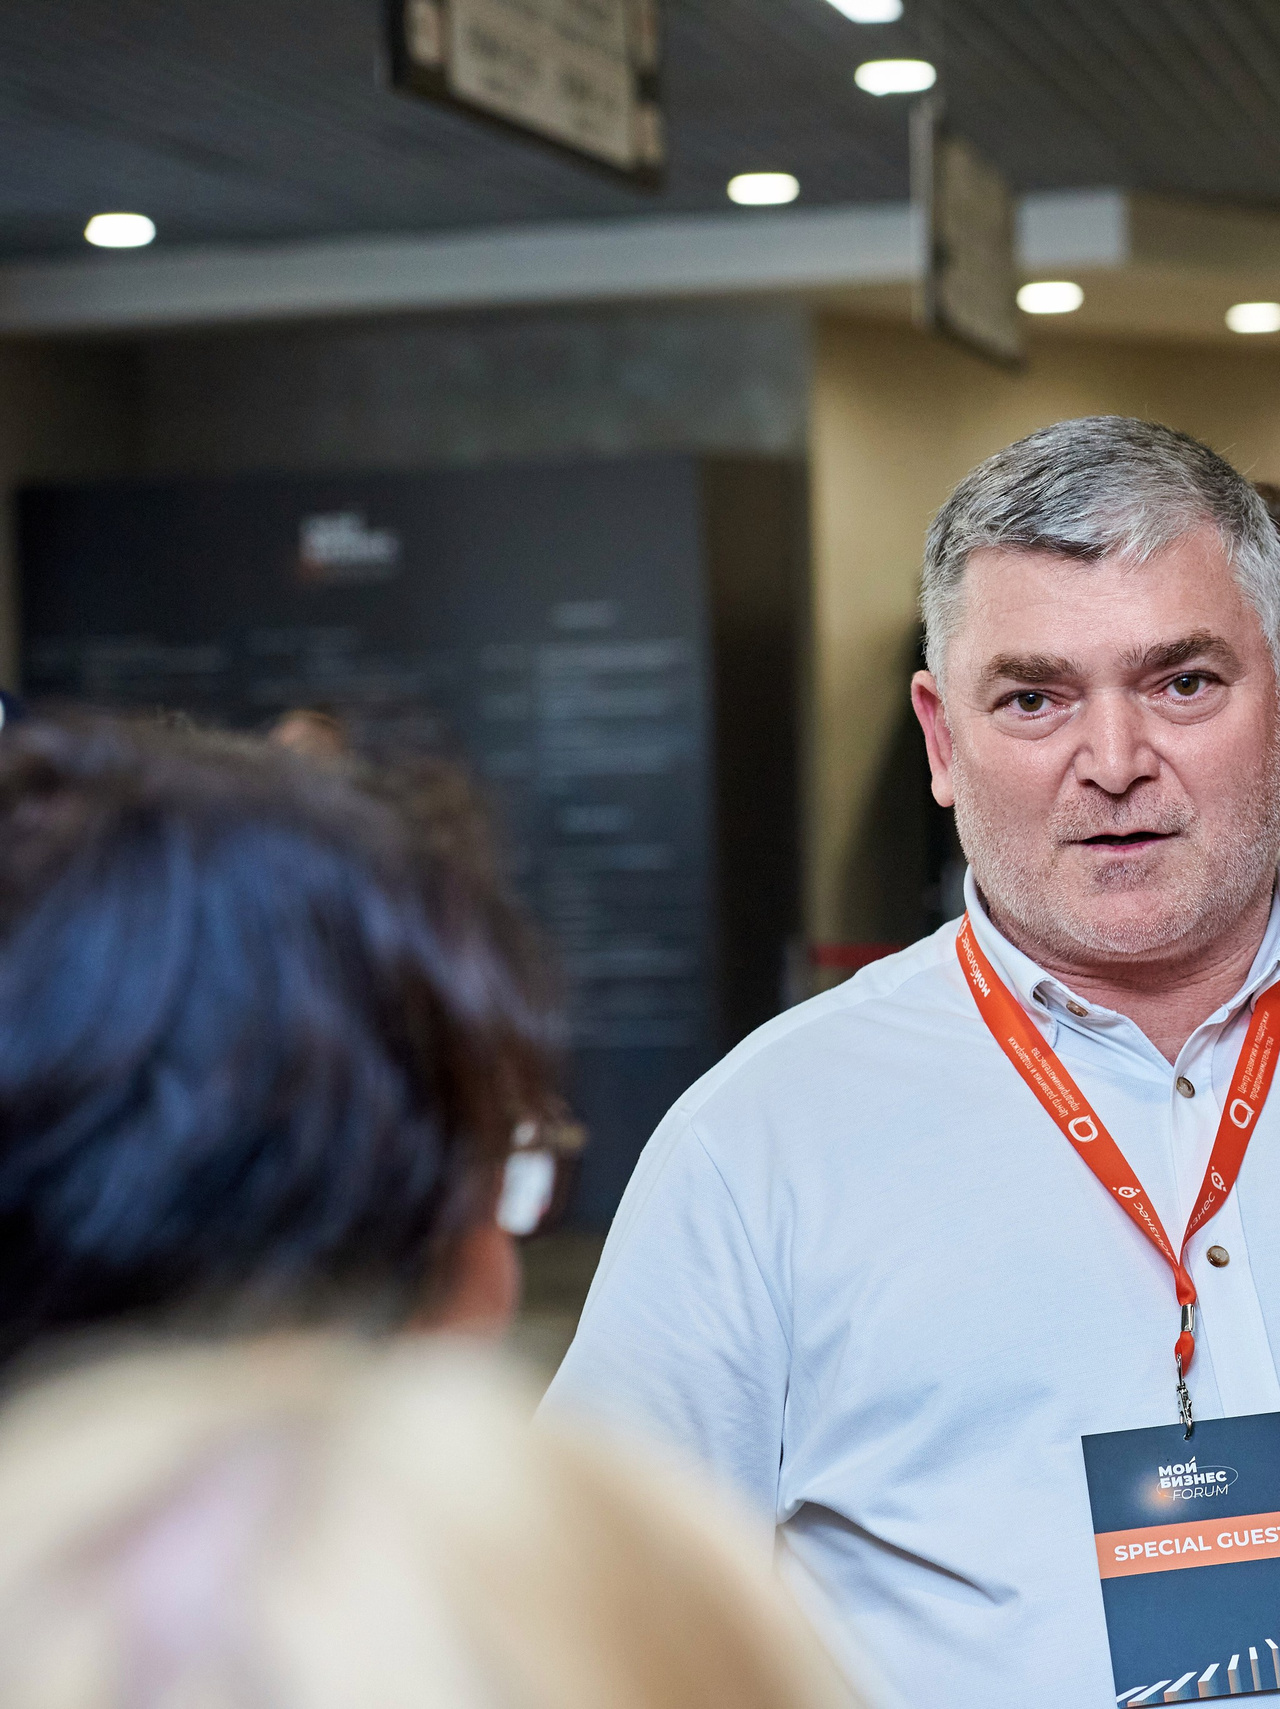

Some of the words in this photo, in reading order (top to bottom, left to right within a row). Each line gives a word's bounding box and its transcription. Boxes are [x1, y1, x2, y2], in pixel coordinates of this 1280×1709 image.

[1007, 1036, 1033, 1069] поддержки
[1237, 1074, 1251, 1094] Центр
[1244, 1047, 1258, 1077] развития
[1254, 1010, 1269, 1044] поддержки
[1030, 1047, 1079, 1111] предпринимательства
[1032, 1071, 1058, 1100] развития
[1051, 1098, 1068, 1117] Центр
[1158, 1456, 1197, 1477] МОЙ
[1160, 1470, 1227, 1489] БИЗНЕС
[1172, 1483, 1229, 1501] FORUM
[1114, 1535, 1212, 1562] SPECIAL
